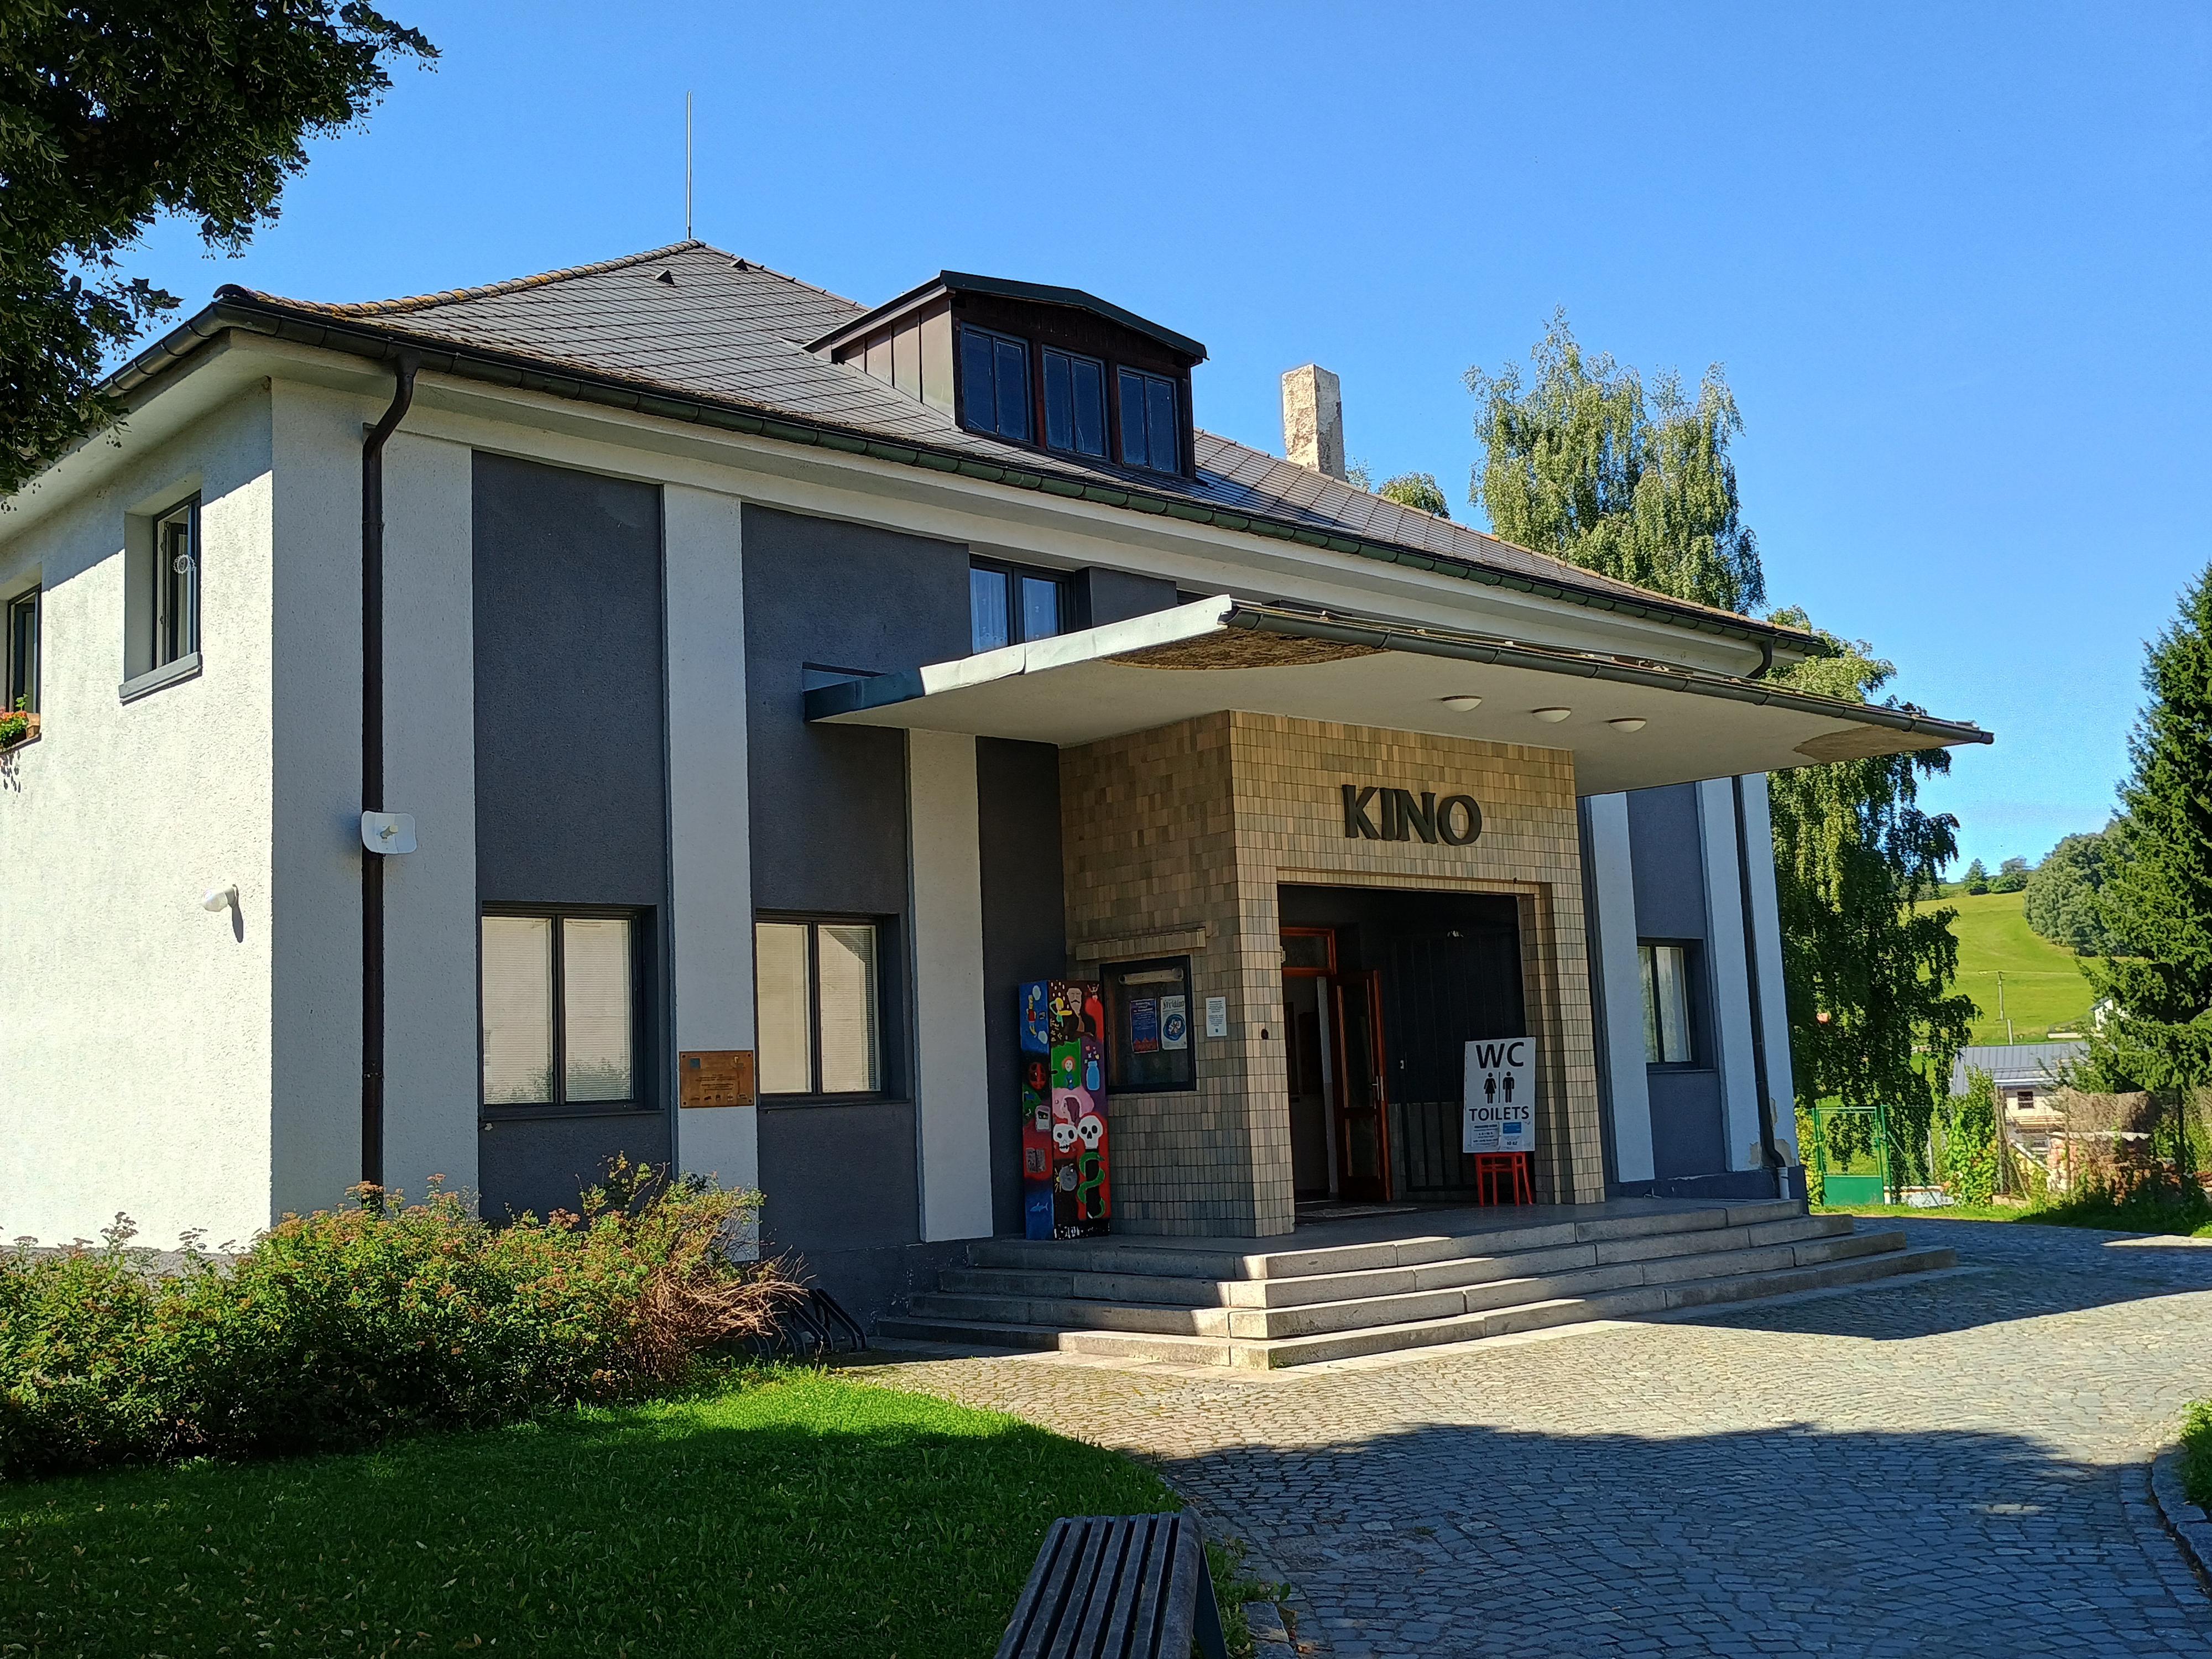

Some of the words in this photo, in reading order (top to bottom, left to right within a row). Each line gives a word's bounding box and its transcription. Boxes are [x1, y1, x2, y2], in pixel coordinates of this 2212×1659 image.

[1342, 784, 1482, 846] KINO
[1475, 1042, 1524, 1068] WC
[1469, 1106, 1529, 1121] TOILETS
